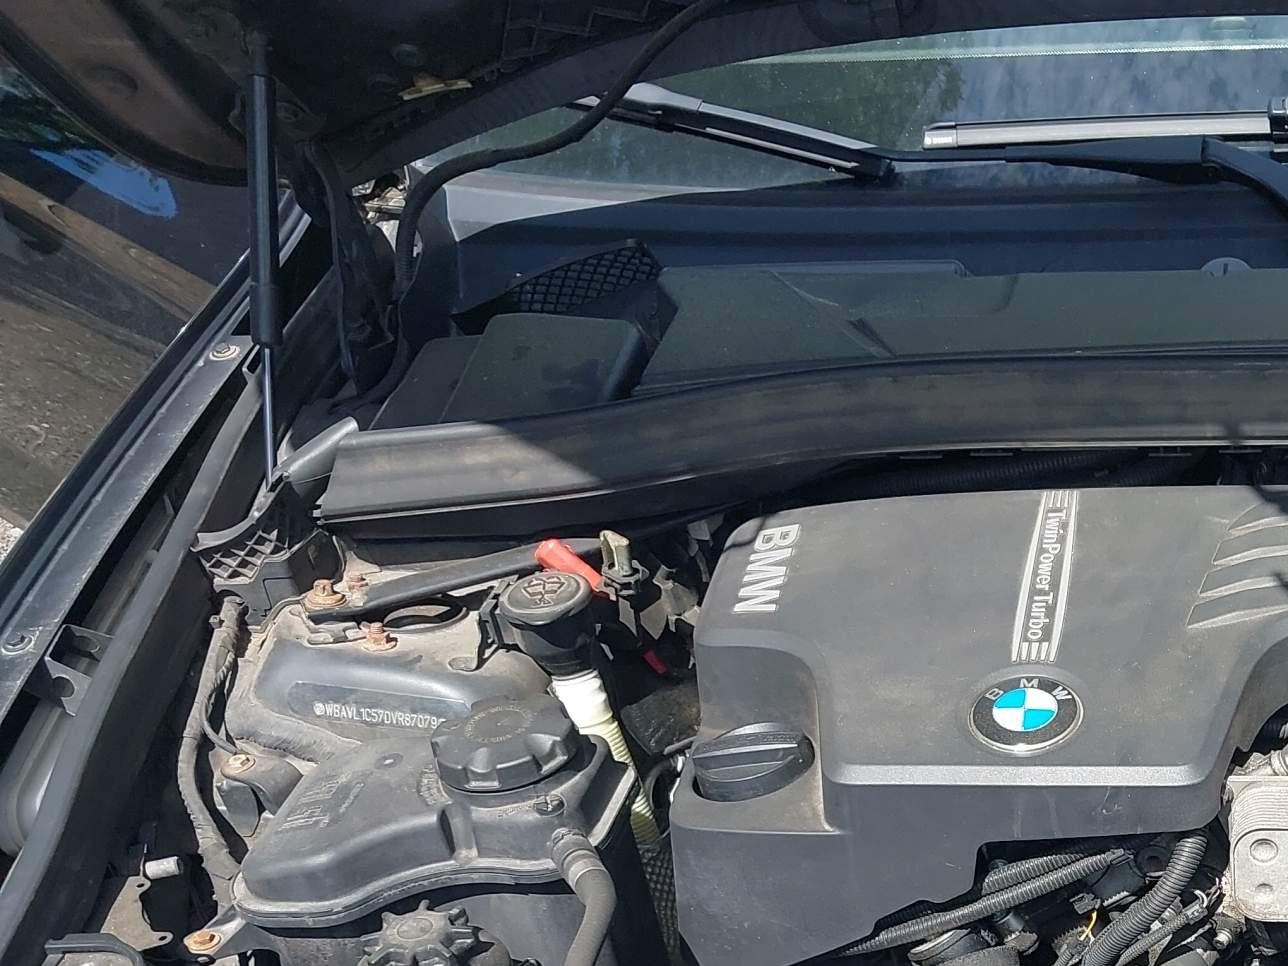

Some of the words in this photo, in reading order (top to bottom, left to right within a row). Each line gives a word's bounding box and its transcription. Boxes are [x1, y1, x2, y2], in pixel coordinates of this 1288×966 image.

[733, 523, 801, 613] BMW
[1036, 508, 1067, 591] TwinPower
[1027, 592, 1055, 641] Turbo
[984, 677, 1073, 702] BMW
